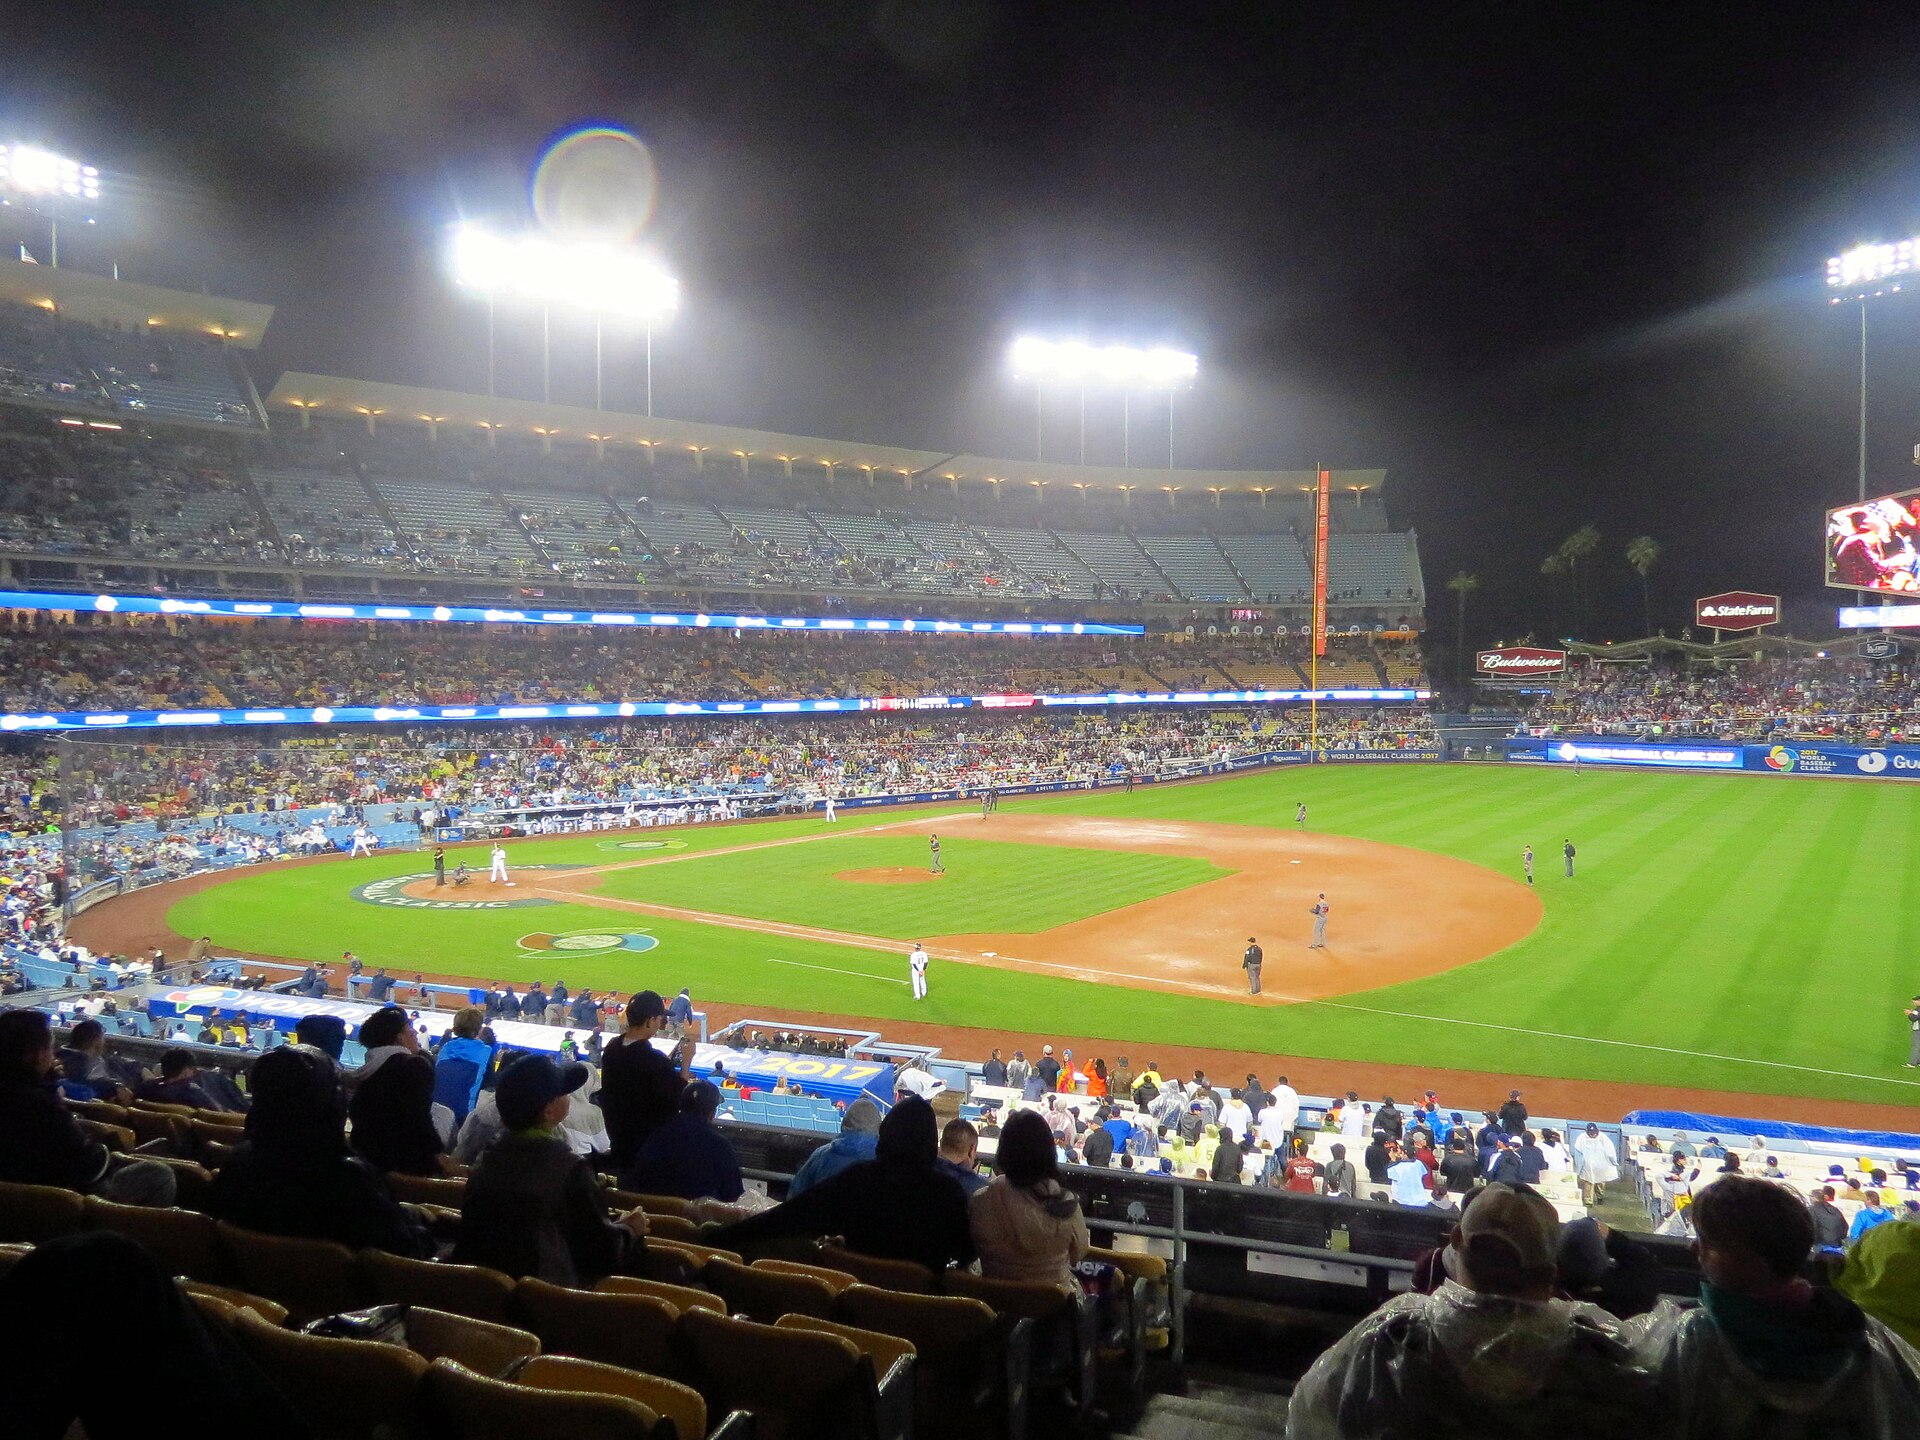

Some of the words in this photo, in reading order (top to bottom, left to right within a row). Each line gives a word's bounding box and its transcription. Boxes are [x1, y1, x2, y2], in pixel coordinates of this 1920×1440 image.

[1481, 655, 1562, 668] Budweiser
[380, 897, 509, 909] CLASSIC
[232, 995, 364, 1020] WORLD
[751, 1057, 883, 1080] 2017
